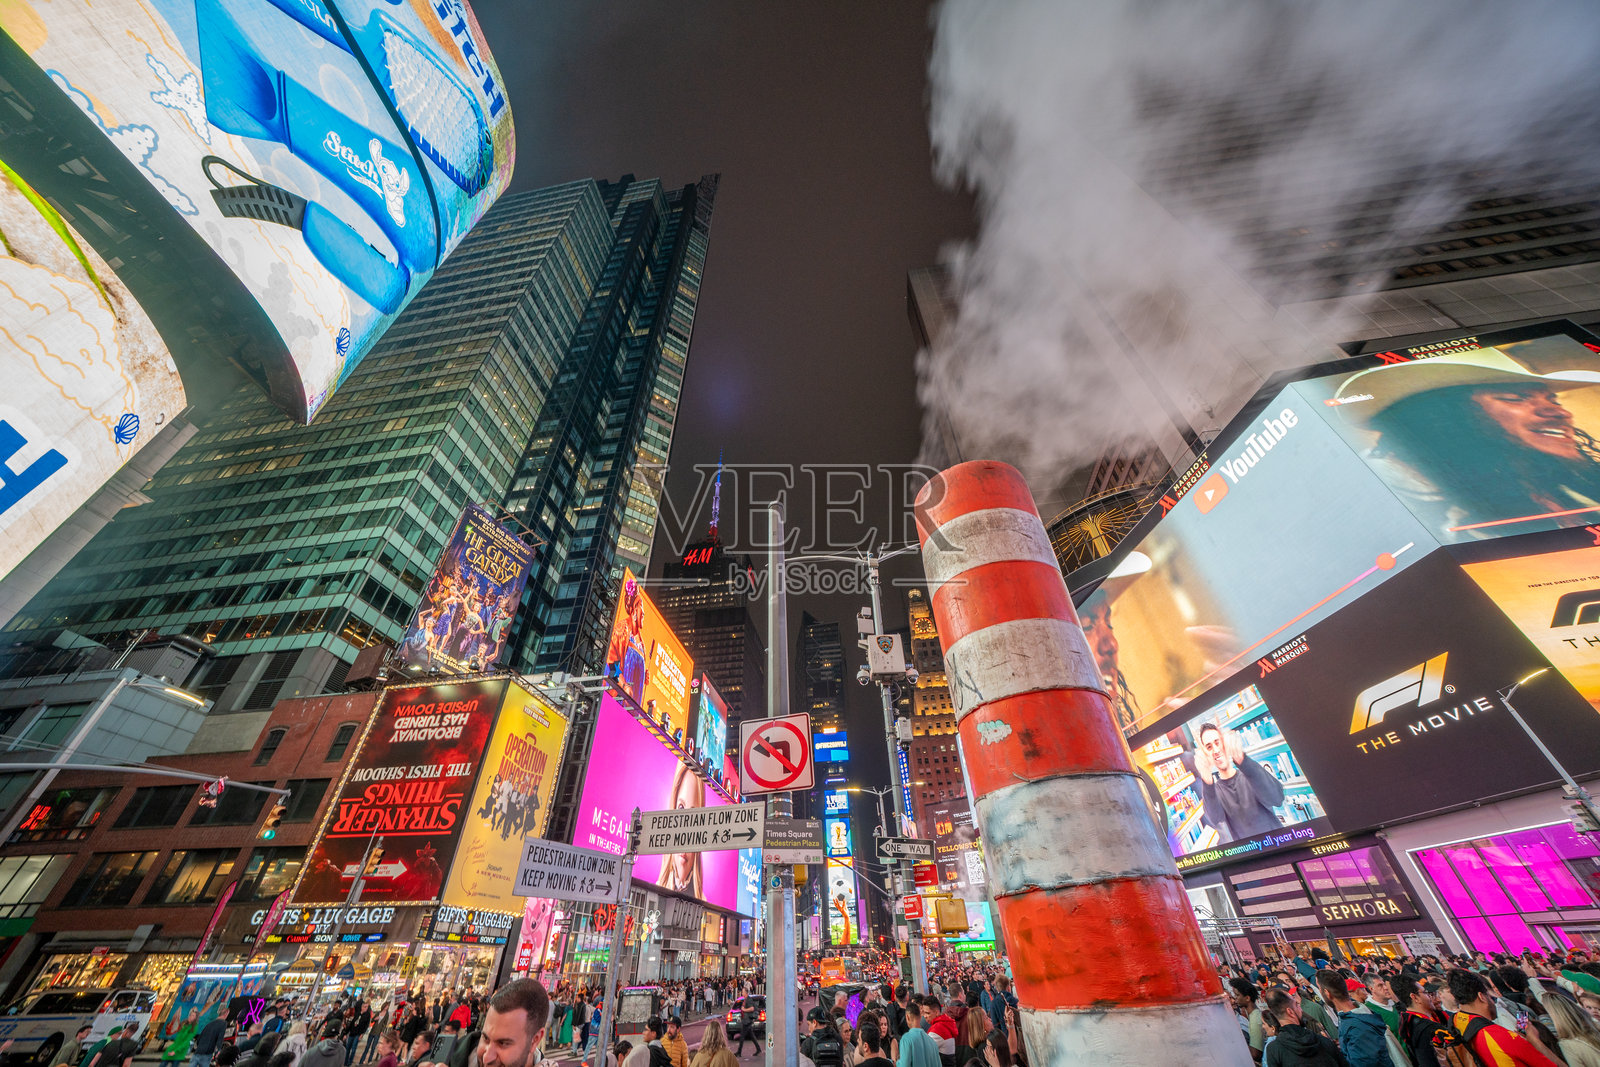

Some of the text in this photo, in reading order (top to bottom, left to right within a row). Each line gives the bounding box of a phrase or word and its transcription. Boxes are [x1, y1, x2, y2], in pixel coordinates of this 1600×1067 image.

[1408, 336, 1479, 354] MARRIOTT
[1219, 408, 1299, 484] YouTube
[1174, 452, 1208, 491] MARRIOTT
[1177, 462, 1209, 499] MARQUIS
[464, 530, 487, 553] THE
[486, 545, 524, 578] GREAT
[683, 547, 713, 566] H&M
[465, 547, 513, 584] GATSBY
[1271, 634, 1307, 659] MARRIOTT
[1562, 636, 1600, 649] TH
[1276, 644, 1307, 666] MARQUIS
[393, 699, 479, 717] UPSIDE DOWN
[394, 712, 470, 730] HAS TURNED
[1356, 696, 1494, 754] THE MOVIE
[388, 726, 463, 743] BROADWAY
[504, 732, 549, 776] OPERATION
[351, 762, 472, 782] THE FIRST SHADOW
[498, 754, 544, 797] MINCEEAT
[361, 781, 447, 807] THINGS
[332, 799, 462, 832] STRANGER
[651, 809, 759, 830] PEDESTRIAN FLOW ZONE
[589, 833, 596, 845] IN
[597, 836, 621, 855] THEATERS
[649, 831, 708, 849] KEEP MOVING
[766, 830, 813, 839] Times Square
[766, 839, 820, 847] Pedestrian Plaza
[885, 843, 927, 853] ONE WAY
[937, 841, 978, 853] YELLOWSTO
[1184, 857, 1194, 867] the
[1194, 850, 1224, 865] LGBTQIA+
[1224, 840, 1262, 858] community
[1263, 835, 1273, 847] all
[1273, 833, 1293, 847] year
[1292, 826, 1314, 839] long
[1312, 840, 1350, 856] SEPHORA
[526, 846, 577, 871] PEDESTRIAN
[578, 854, 598, 873] FLOW
[599, 857, 617, 876] ZONE
[521, 869, 577, 891] KEEP MOVING
[251, 909, 302, 926] GTS
[437, 906, 514, 930] GIFTS LUGGAGE
[1322, 899, 1402, 921] SEPHORA
[302, 924, 330, 934] I NY
[473, 925, 484, 934] NY
[593, 903, 635, 947] Disey
[314, 934, 339, 943] SON
[480, 936, 496, 944] SONY
[521, 949, 532, 957] MINI
